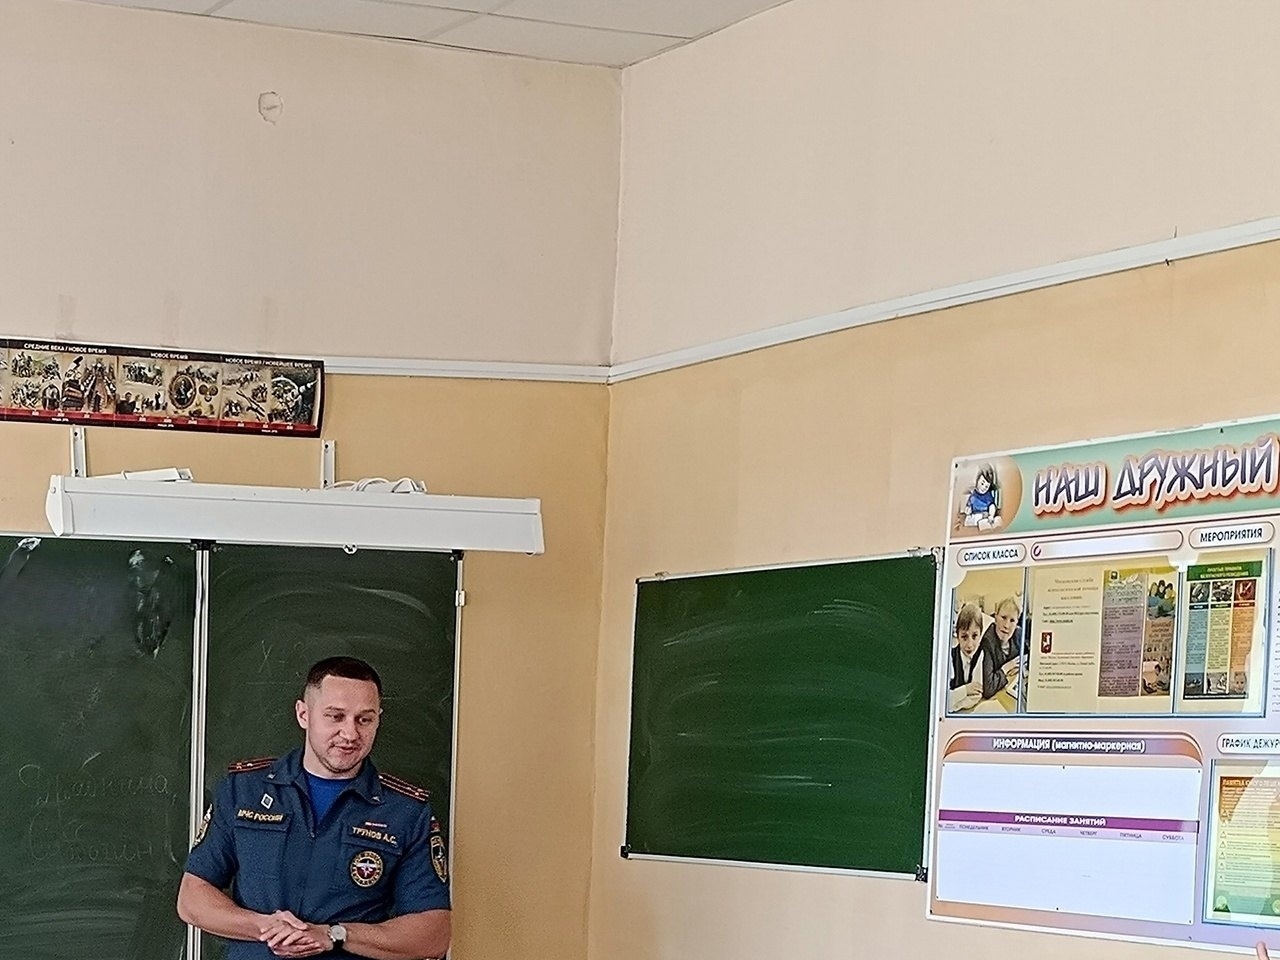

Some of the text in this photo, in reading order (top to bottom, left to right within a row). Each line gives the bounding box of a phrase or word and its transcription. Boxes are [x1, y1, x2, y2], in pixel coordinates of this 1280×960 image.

[1033, 434, 1278, 511] НАШ ДРУЖНЫЙ
[1199, 527, 1264, 544] МЕРОПРИЯТИЯ
[963, 548, 1019, 563] СПИСОК КЛАССА
[992, 738, 1051, 751] ИНФОРМАЦИЯ
[1221, 738, 1251, 749] ГРАФИК
[1014, 815, 1106, 826] РАСПИСАНИЕ ЗАНЯТИЙ
